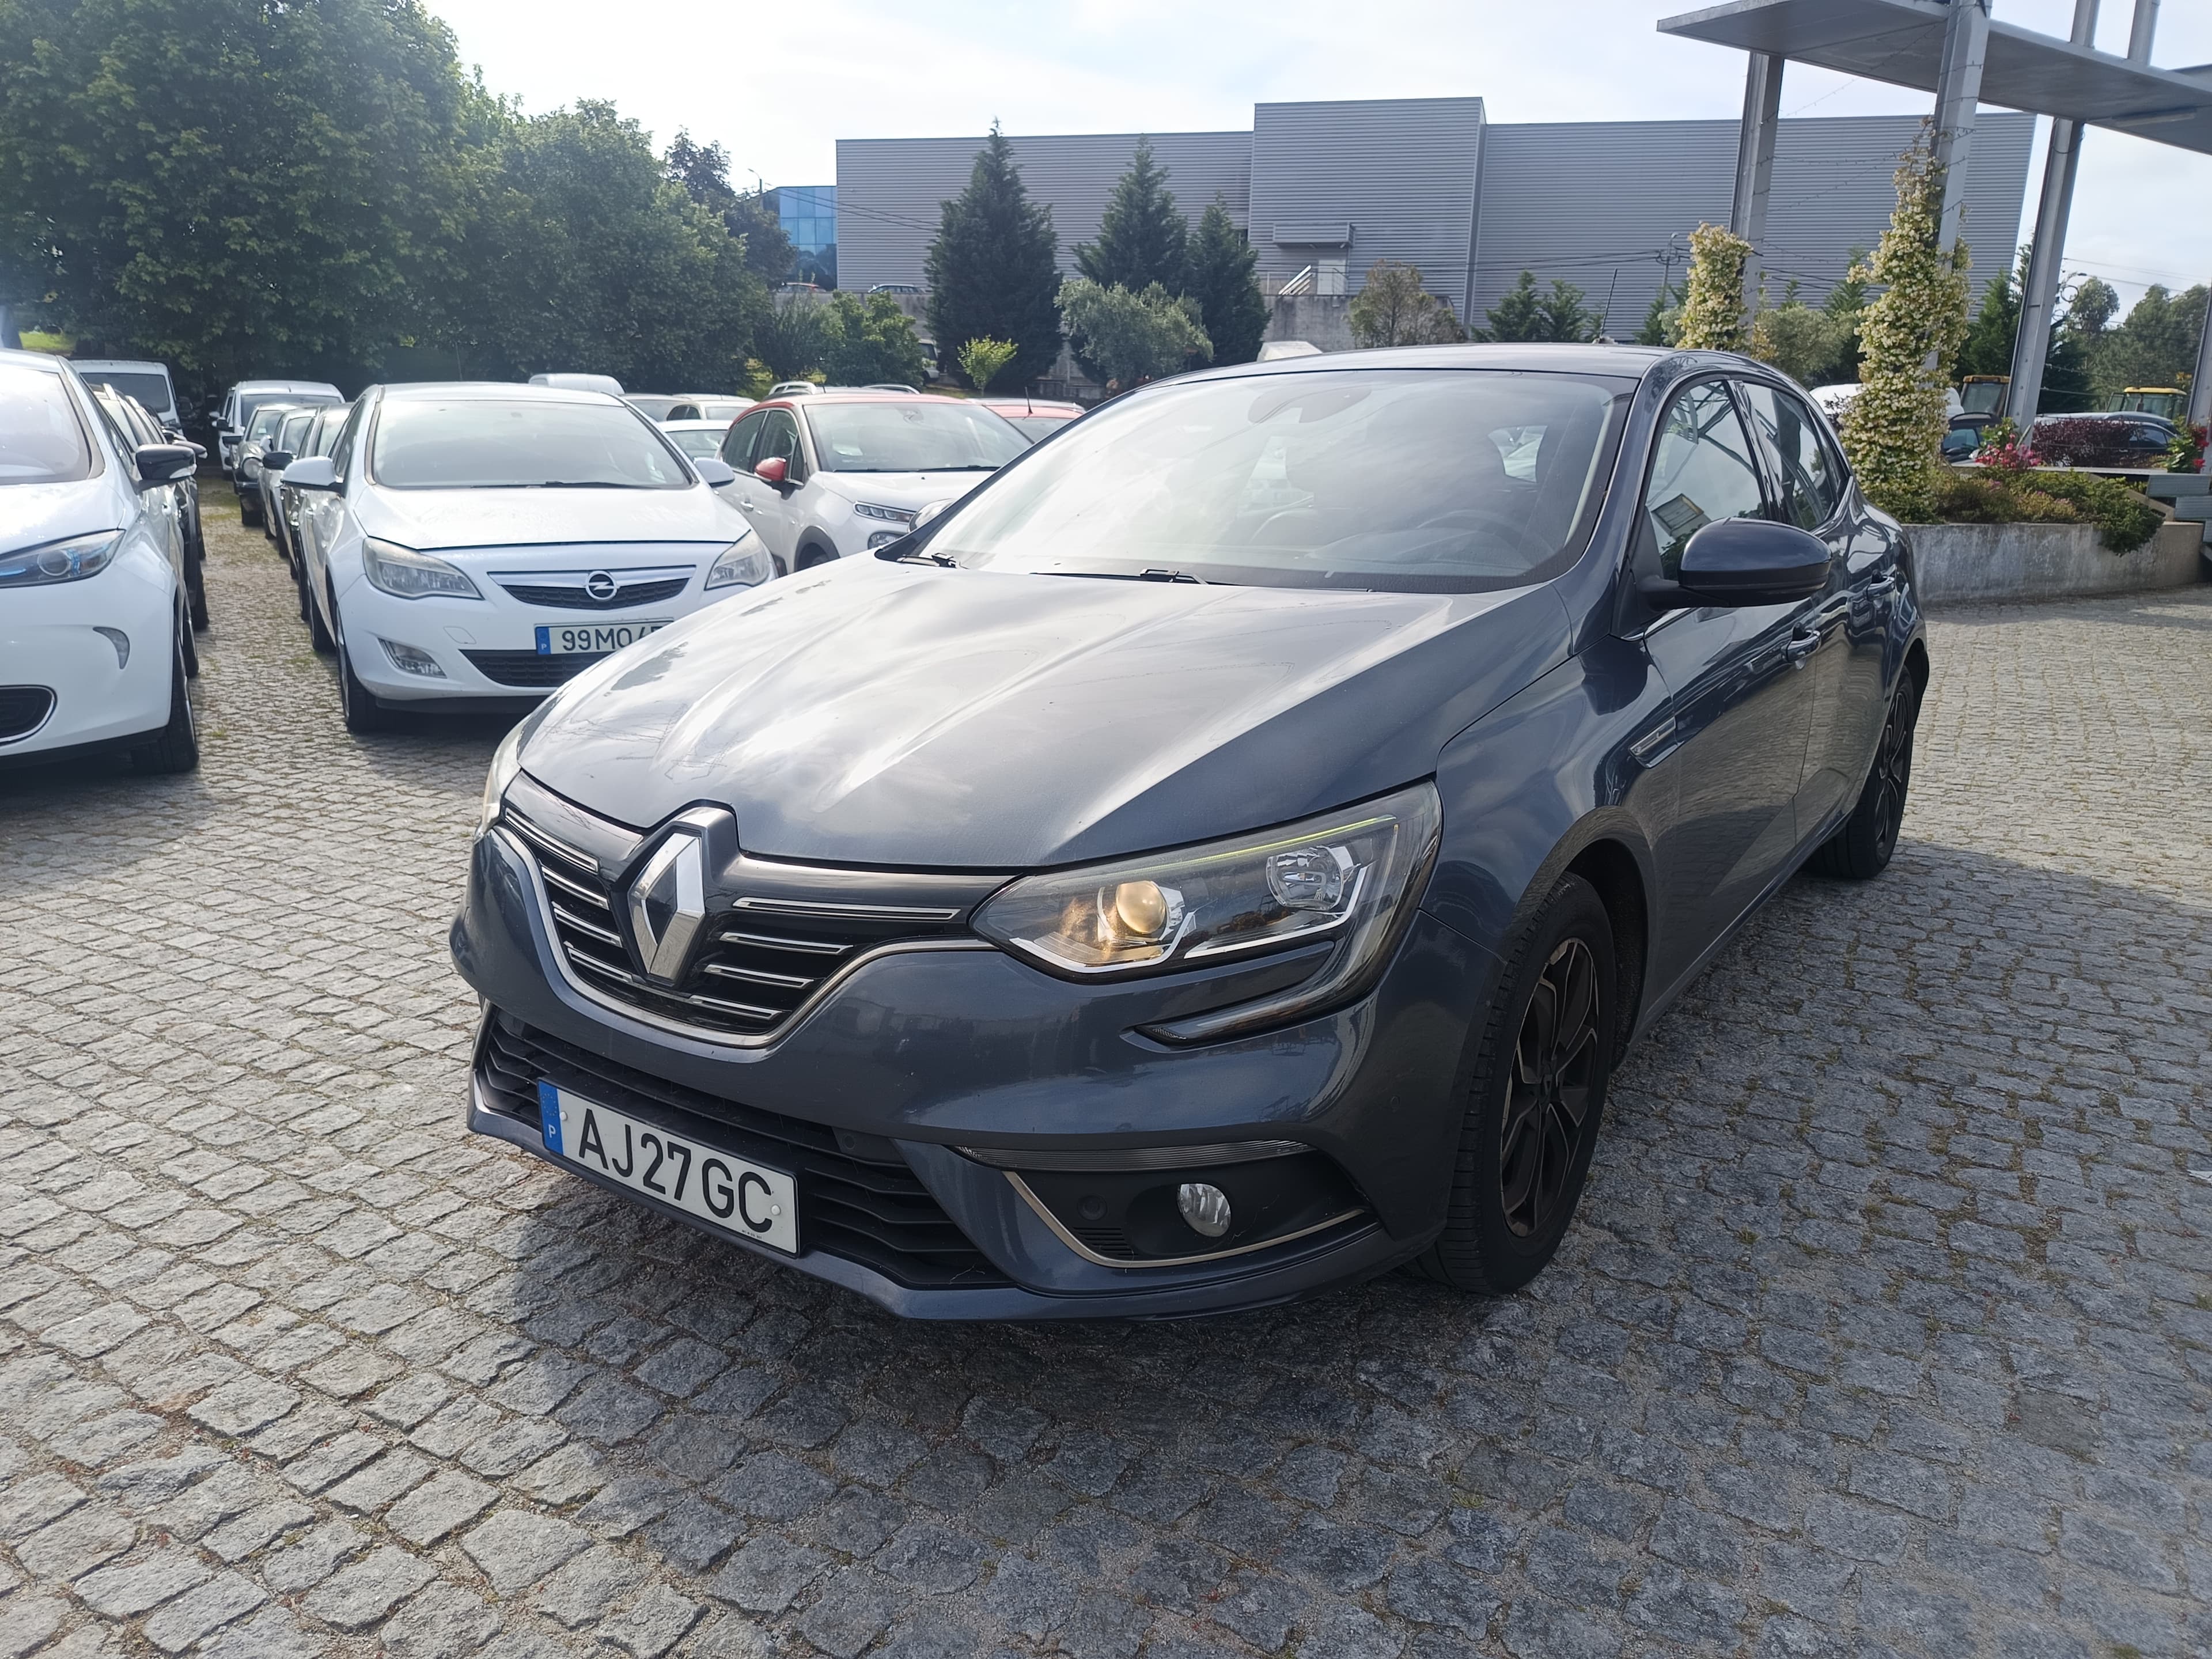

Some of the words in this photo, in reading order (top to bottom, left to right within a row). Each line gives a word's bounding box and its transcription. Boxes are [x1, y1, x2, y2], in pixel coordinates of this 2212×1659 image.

[562, 626, 663, 651] 99MO
[548, 1124, 556, 1138] P
[579, 1108, 772, 1233] AJ27GC
